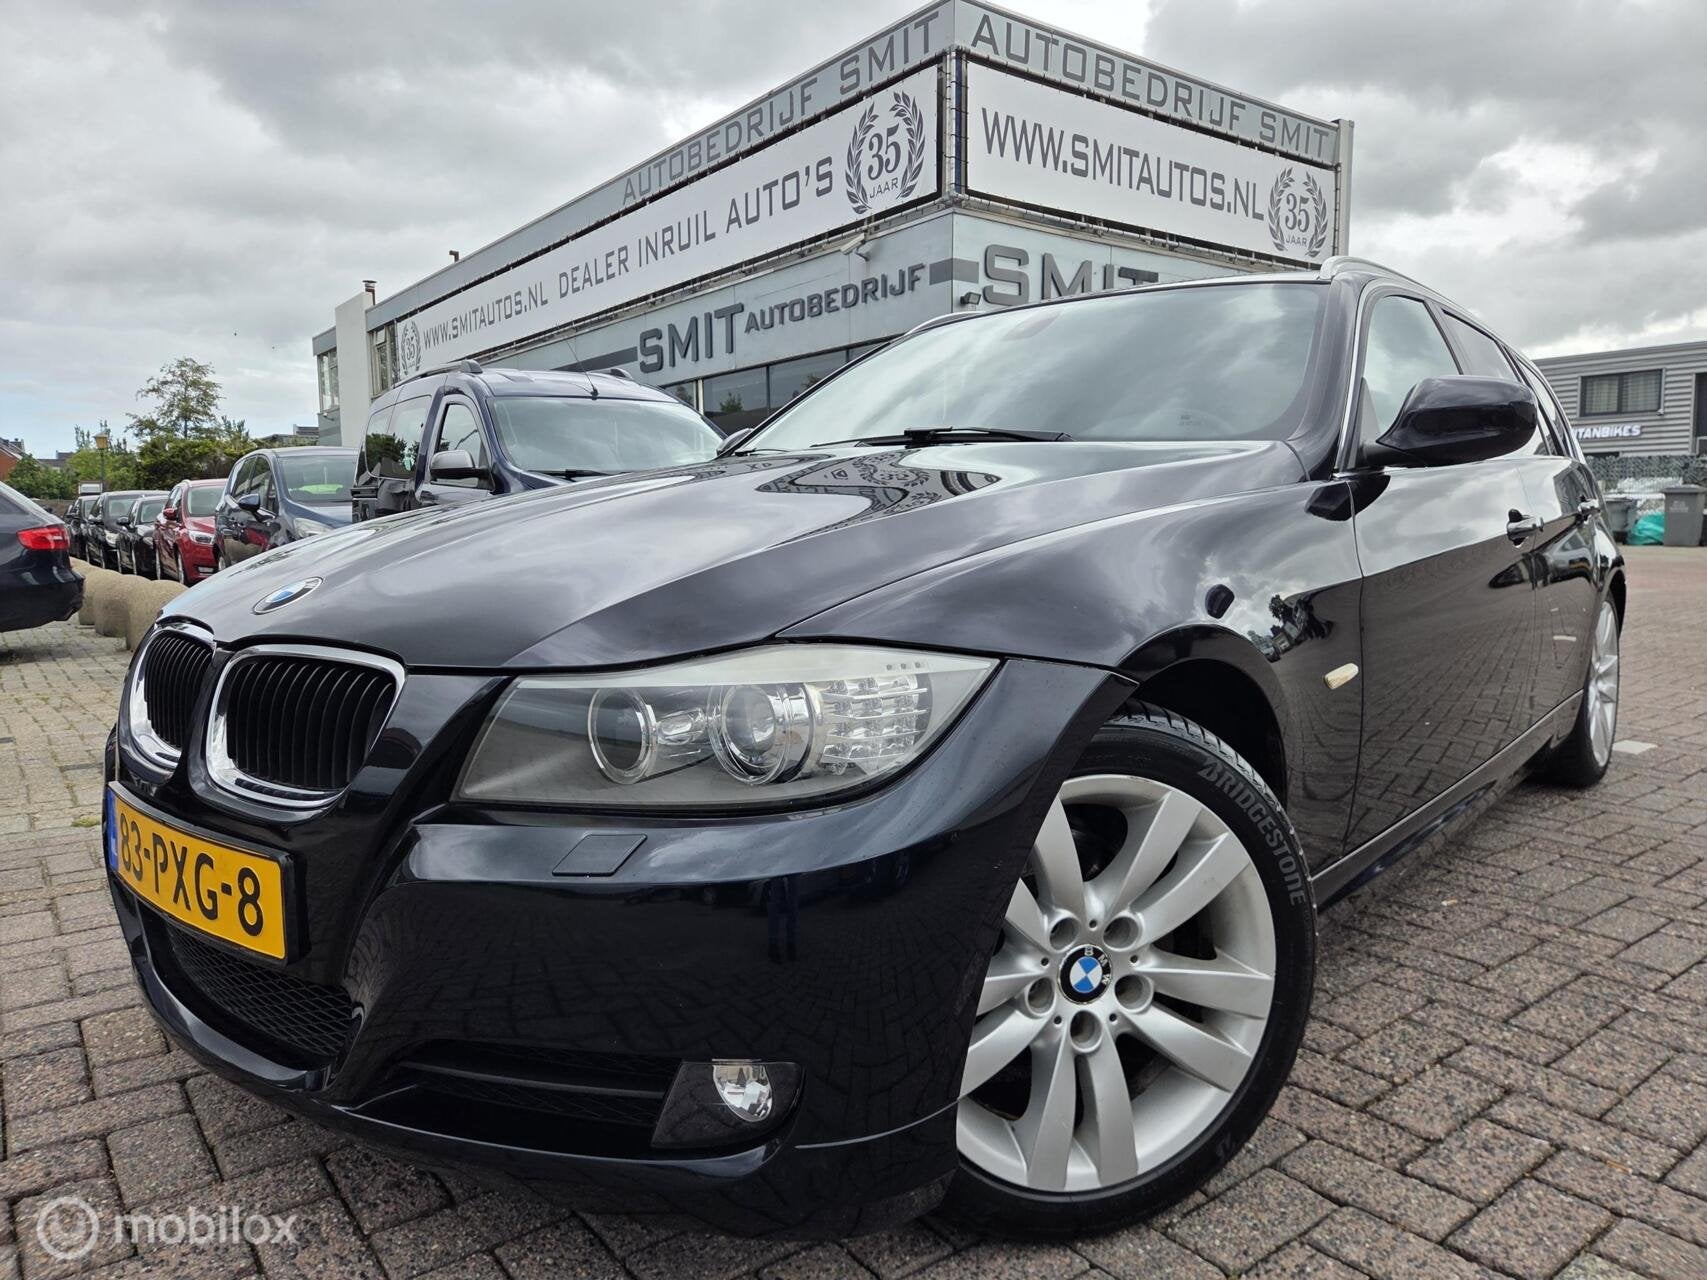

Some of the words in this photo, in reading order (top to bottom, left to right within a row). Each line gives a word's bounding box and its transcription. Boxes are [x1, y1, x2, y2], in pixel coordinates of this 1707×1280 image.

[622, 77, 818, 205] AUTOBEDRIJF
[839, 11, 939, 95] SMIT
[971, 14, 1246, 128] AUTOBEDRIJF
[1259, 112, 1330, 158] SMIT
[868, 122, 901, 180] 35
[870, 177, 899, 199] JAAR
[981, 107, 1265, 221] WWW.SMITAUTOS.NL
[423, 281, 549, 350] WWW.SMITAUTOS.NL
[558, 245, 630, 299] DEALER
[638, 210, 716, 267] INRUIL
[726, 156, 833, 234] AUTO'S
[1285, 193, 1310, 232] 35
[1286, 235, 1308, 247] JAAR
[639, 302, 745, 374] SMIT
[744, 263, 925, 334] AUTOBEDRIJF
[119, 812, 264, 937] 83-PXG-8
[1197, 755, 1306, 906] BRIDGESTONE
